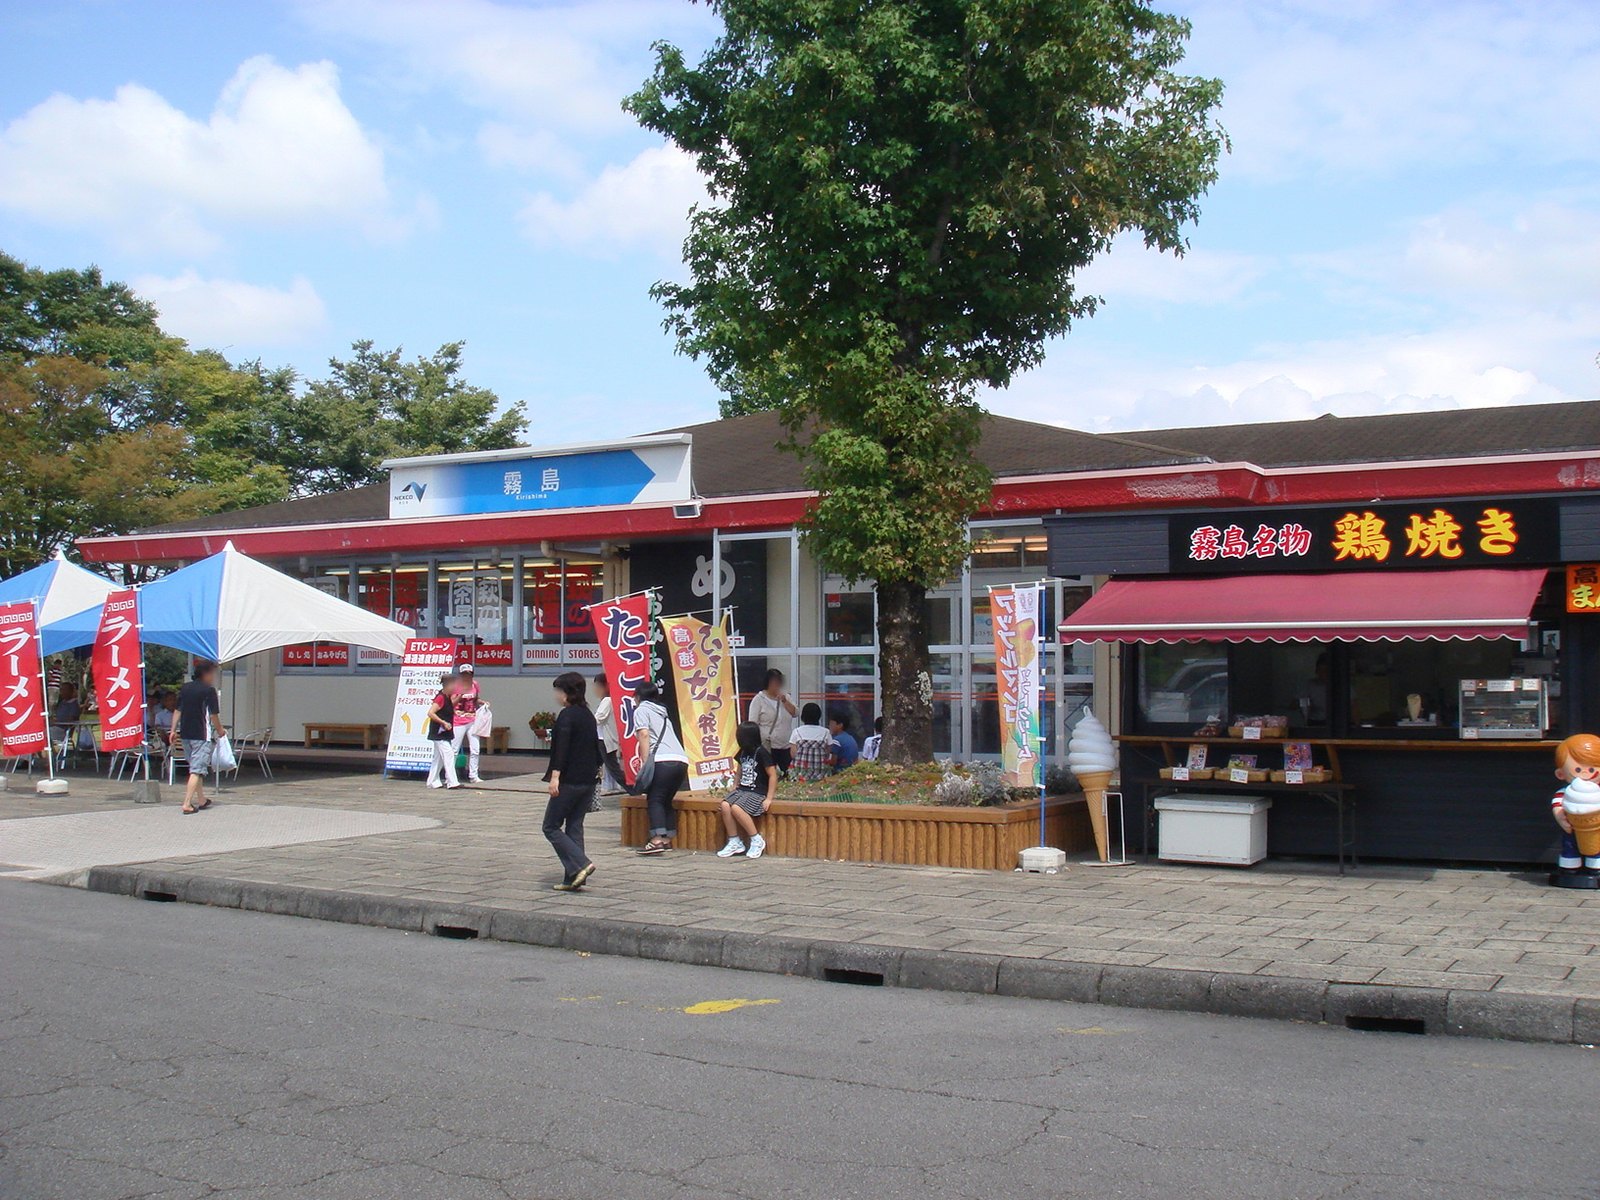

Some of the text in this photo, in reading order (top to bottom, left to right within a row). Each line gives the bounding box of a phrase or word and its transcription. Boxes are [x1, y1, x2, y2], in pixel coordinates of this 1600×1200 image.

[503, 467, 560, 496] 霧島
[516, 493, 548, 501] Kirishima
[1189, 508, 1519, 562] 霧島名物 鶏焼き
[410, 642, 451, 652] ETC レーン
[288, 650, 347, 660] めし処 おみやげ処
[476, 649, 511, 659] おみやげ処
[526, 648, 600, 659] DINNING STORES
[101, 616, 136, 725] ラーメン
[0, 627, 35, 731] ラーメン
